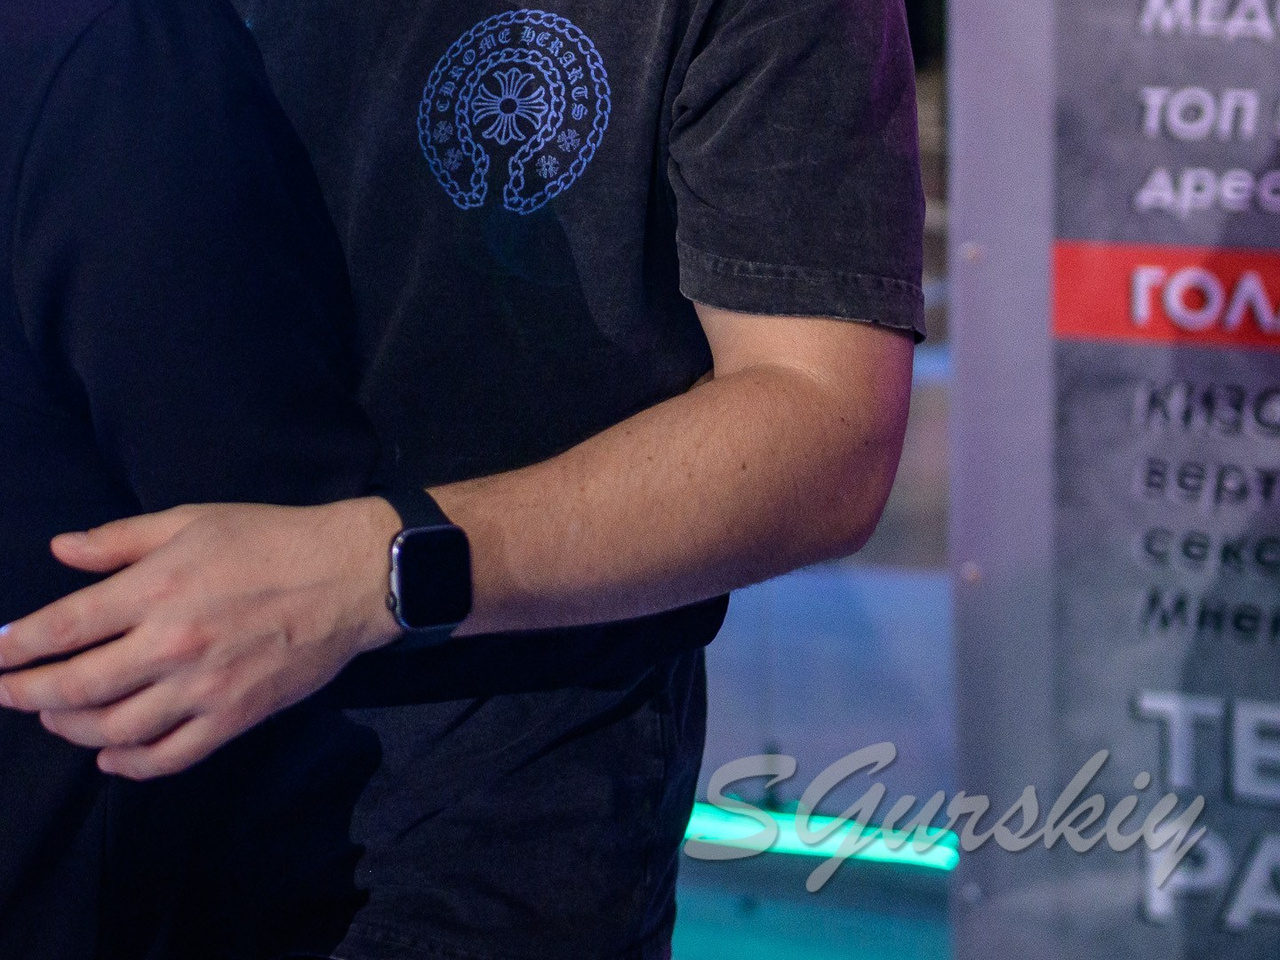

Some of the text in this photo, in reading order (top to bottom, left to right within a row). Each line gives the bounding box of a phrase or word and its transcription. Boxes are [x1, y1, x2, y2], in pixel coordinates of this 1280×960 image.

[436, 28, 511, 111] CHROME
[1131, 266, 1280, 331] ГОЛ
[1144, 588, 1280, 638] Мне
